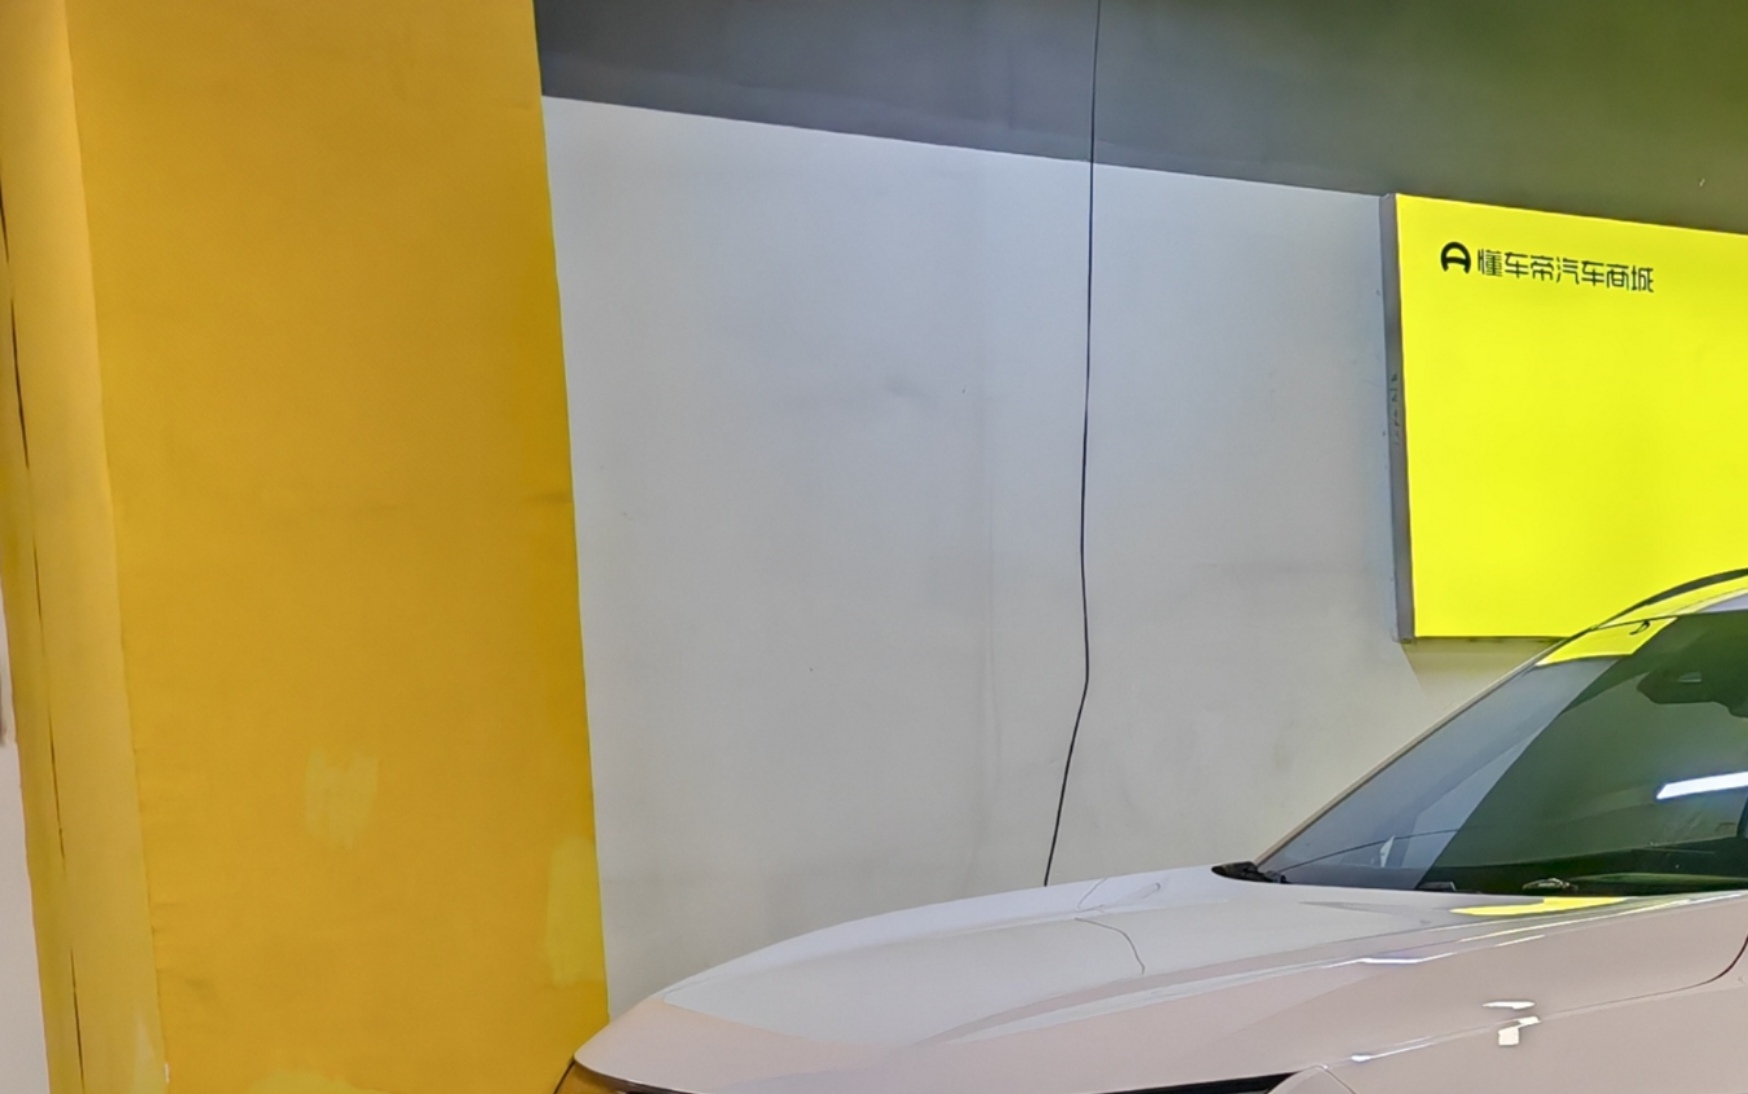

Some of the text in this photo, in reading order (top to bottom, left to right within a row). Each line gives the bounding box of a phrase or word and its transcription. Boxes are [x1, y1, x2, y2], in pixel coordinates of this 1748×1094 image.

[1477, 249, 1654, 293] 懂车帝汽车商城
